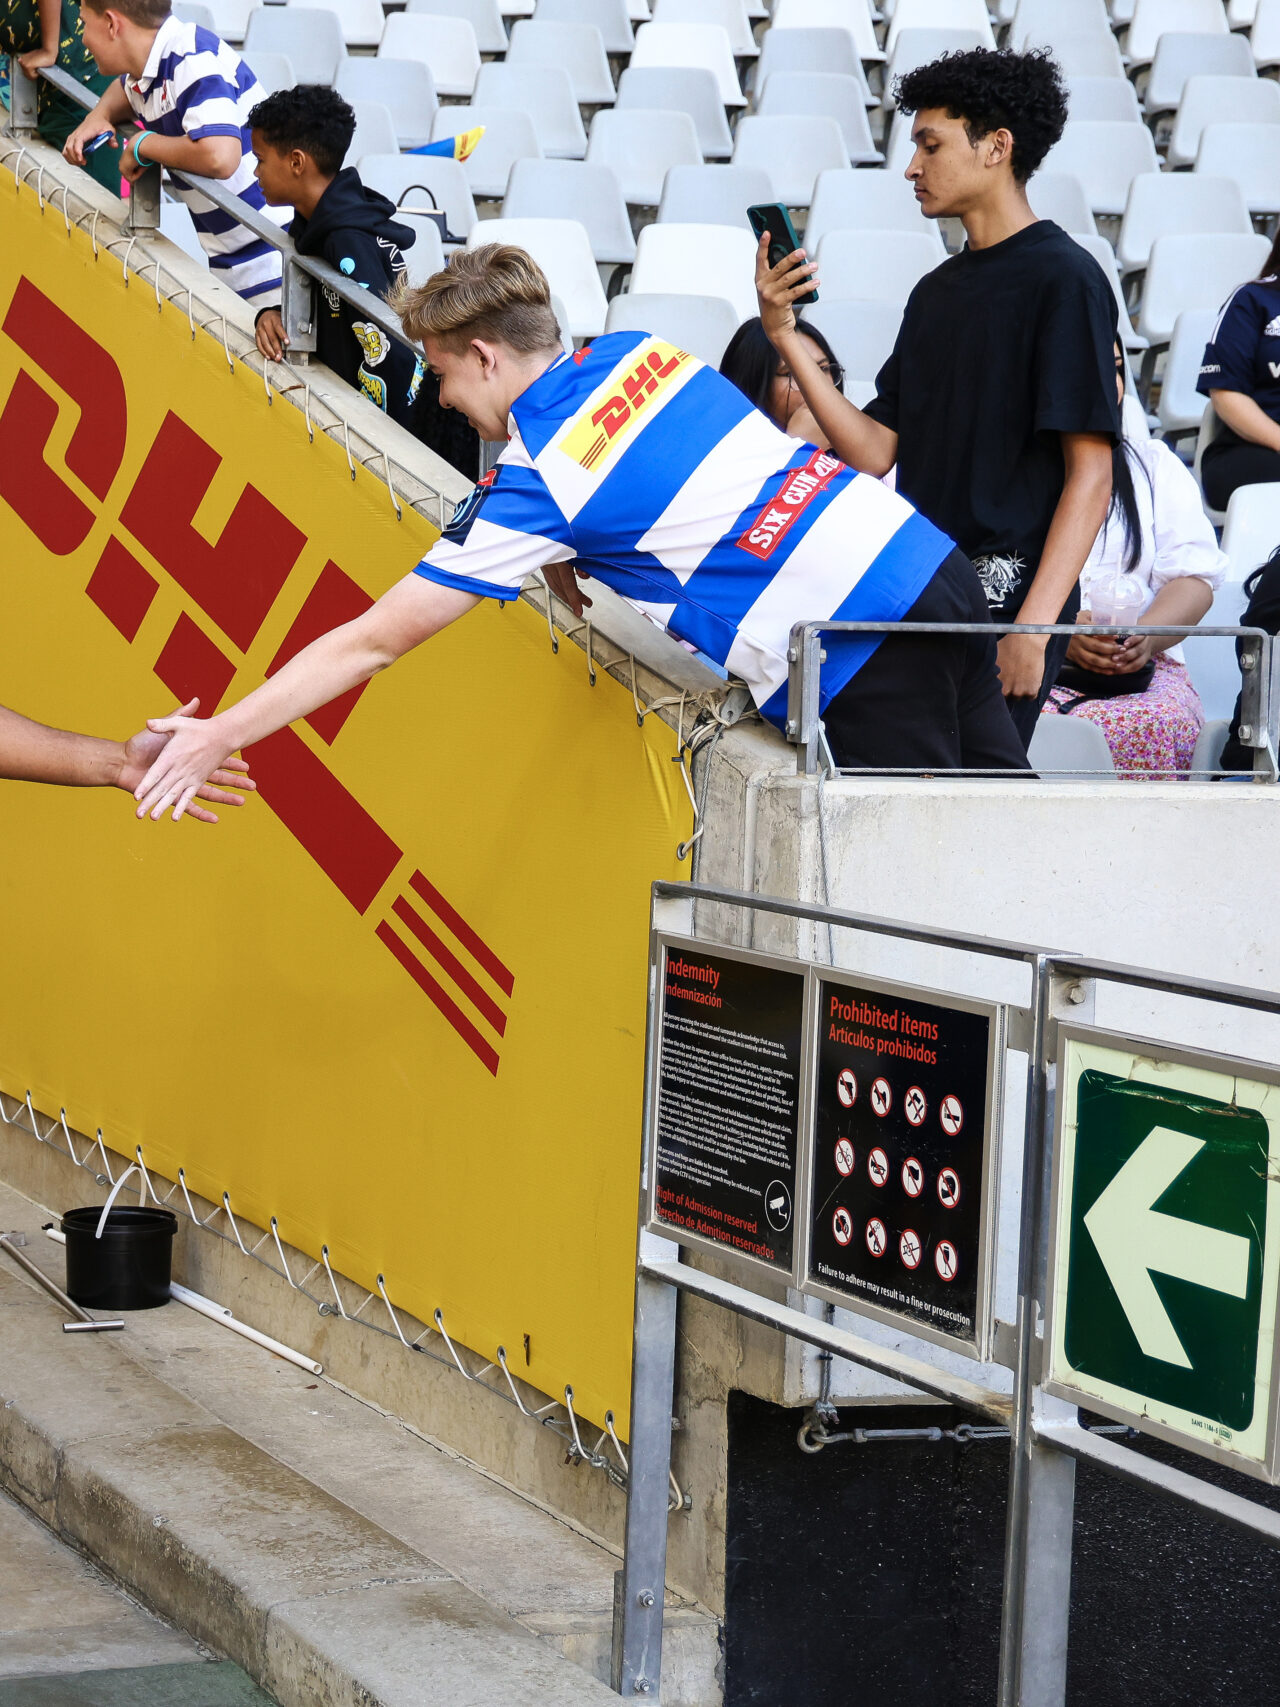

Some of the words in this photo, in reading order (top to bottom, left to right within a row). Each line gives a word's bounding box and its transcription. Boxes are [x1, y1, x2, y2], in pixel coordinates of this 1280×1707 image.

[592, 351, 680, 441] DHL
[748, 507, 793, 550] SIX
[782, 470, 820, 505] GUN
[666, 956, 720, 989] Indemnity
[829, 1024, 875, 1050] Artículos
[877, 1038, 936, 1064] prohibidos
[830, 997, 898, 1031] Prohibited
[901, 1012, 938, 1040] items
[656, 1204, 685, 1224] Derecho
[685, 1216, 695, 1229] de
[697, 1220, 731, 1242] Admition
[733, 1236, 774, 1259] reservados
[657, 1186, 675, 1203] Right
[676, 1194, 684, 1205] of
[685, 1197, 723, 1220] Admission
[724, 1214, 757, 1234] reserved
[818, 1263, 837, 1276] Failure
[839, 1271, 845, 1280] to
[846, 1274, 866, 1288] adhere
[867, 1283, 879, 1295] may
[881, 1287, 898, 1299] result
[899, 1292, 905, 1302] in
[906, 1296, 910, 1304] a
[911, 1296, 923, 1309] fine
[924, 1302, 931, 1311] or
[932, 1306, 970, 1324] prosecution
